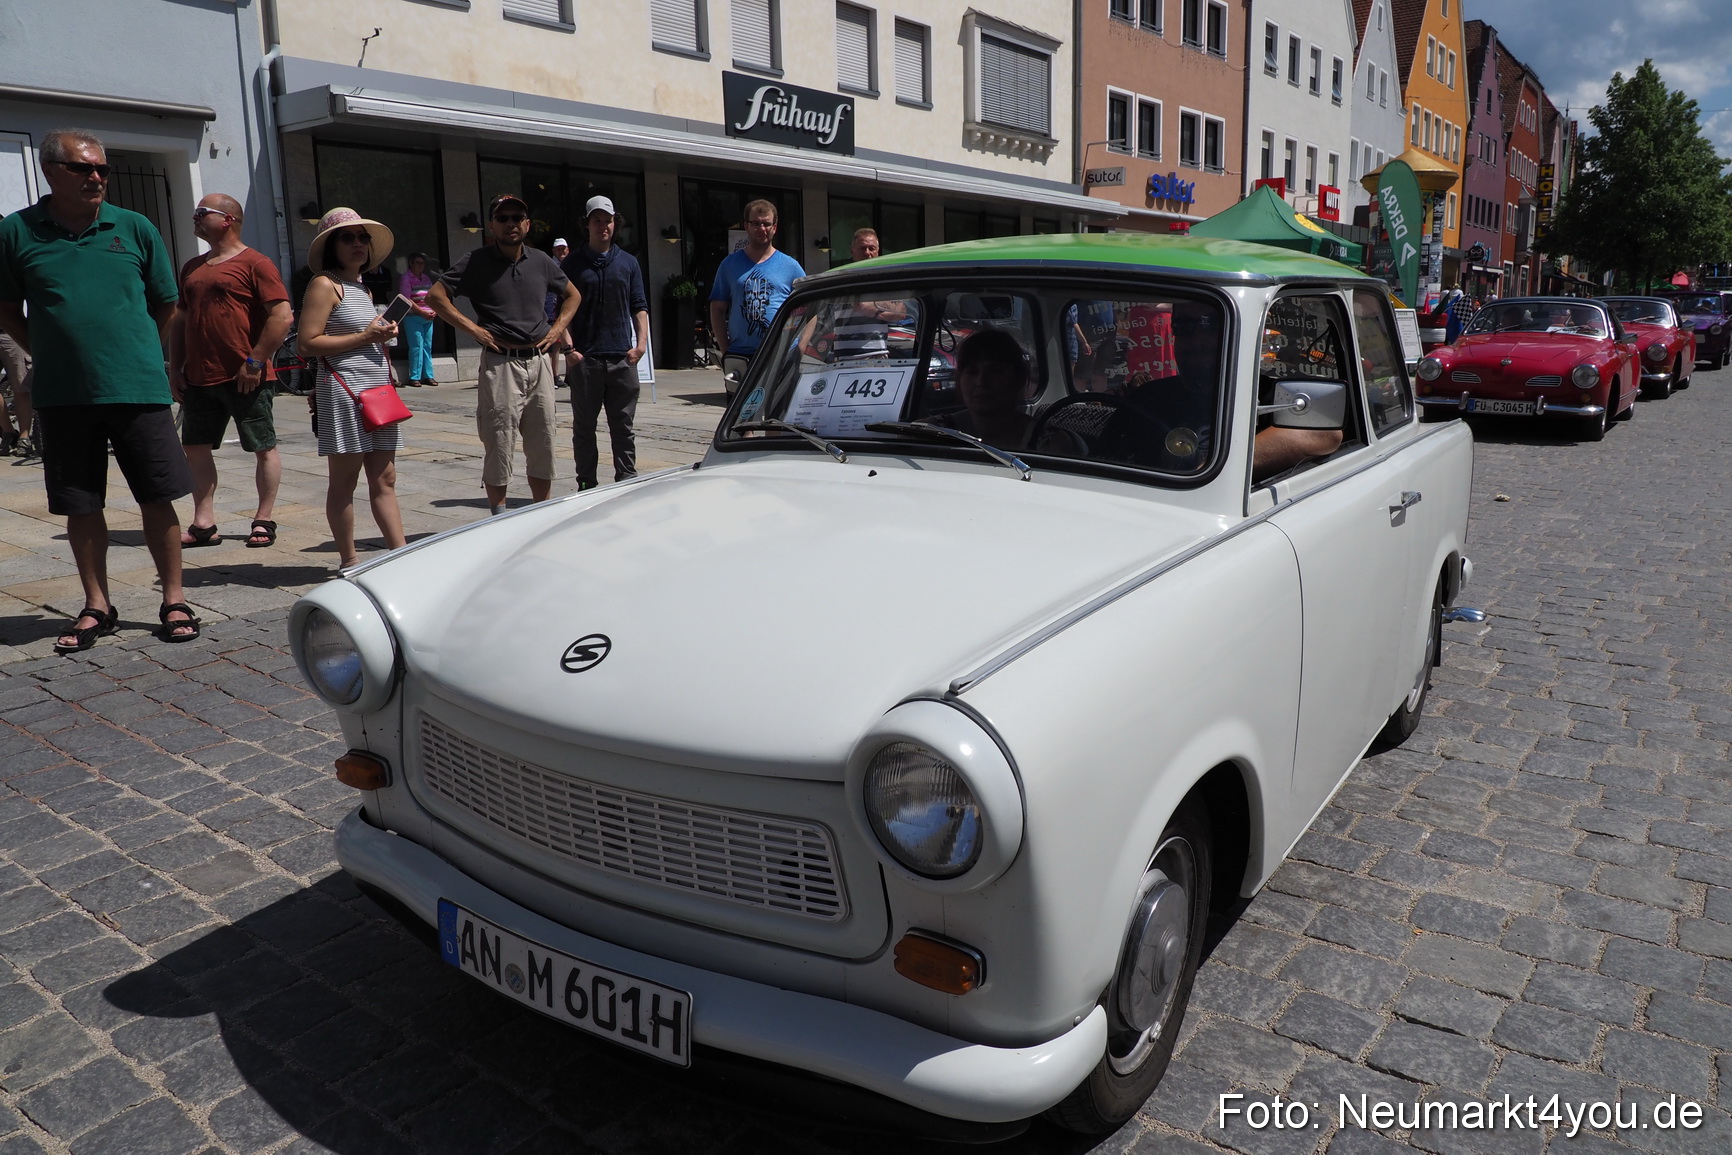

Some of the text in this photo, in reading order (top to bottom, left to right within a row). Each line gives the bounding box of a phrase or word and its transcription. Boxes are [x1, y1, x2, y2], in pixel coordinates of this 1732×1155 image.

[1538, 165, 1553, 238] HOTEL
[844, 378, 887, 398] 443
[1474, 400, 1487, 411] FÜ
[461, 919, 502, 985] AN
[528, 949, 553, 1008] M
